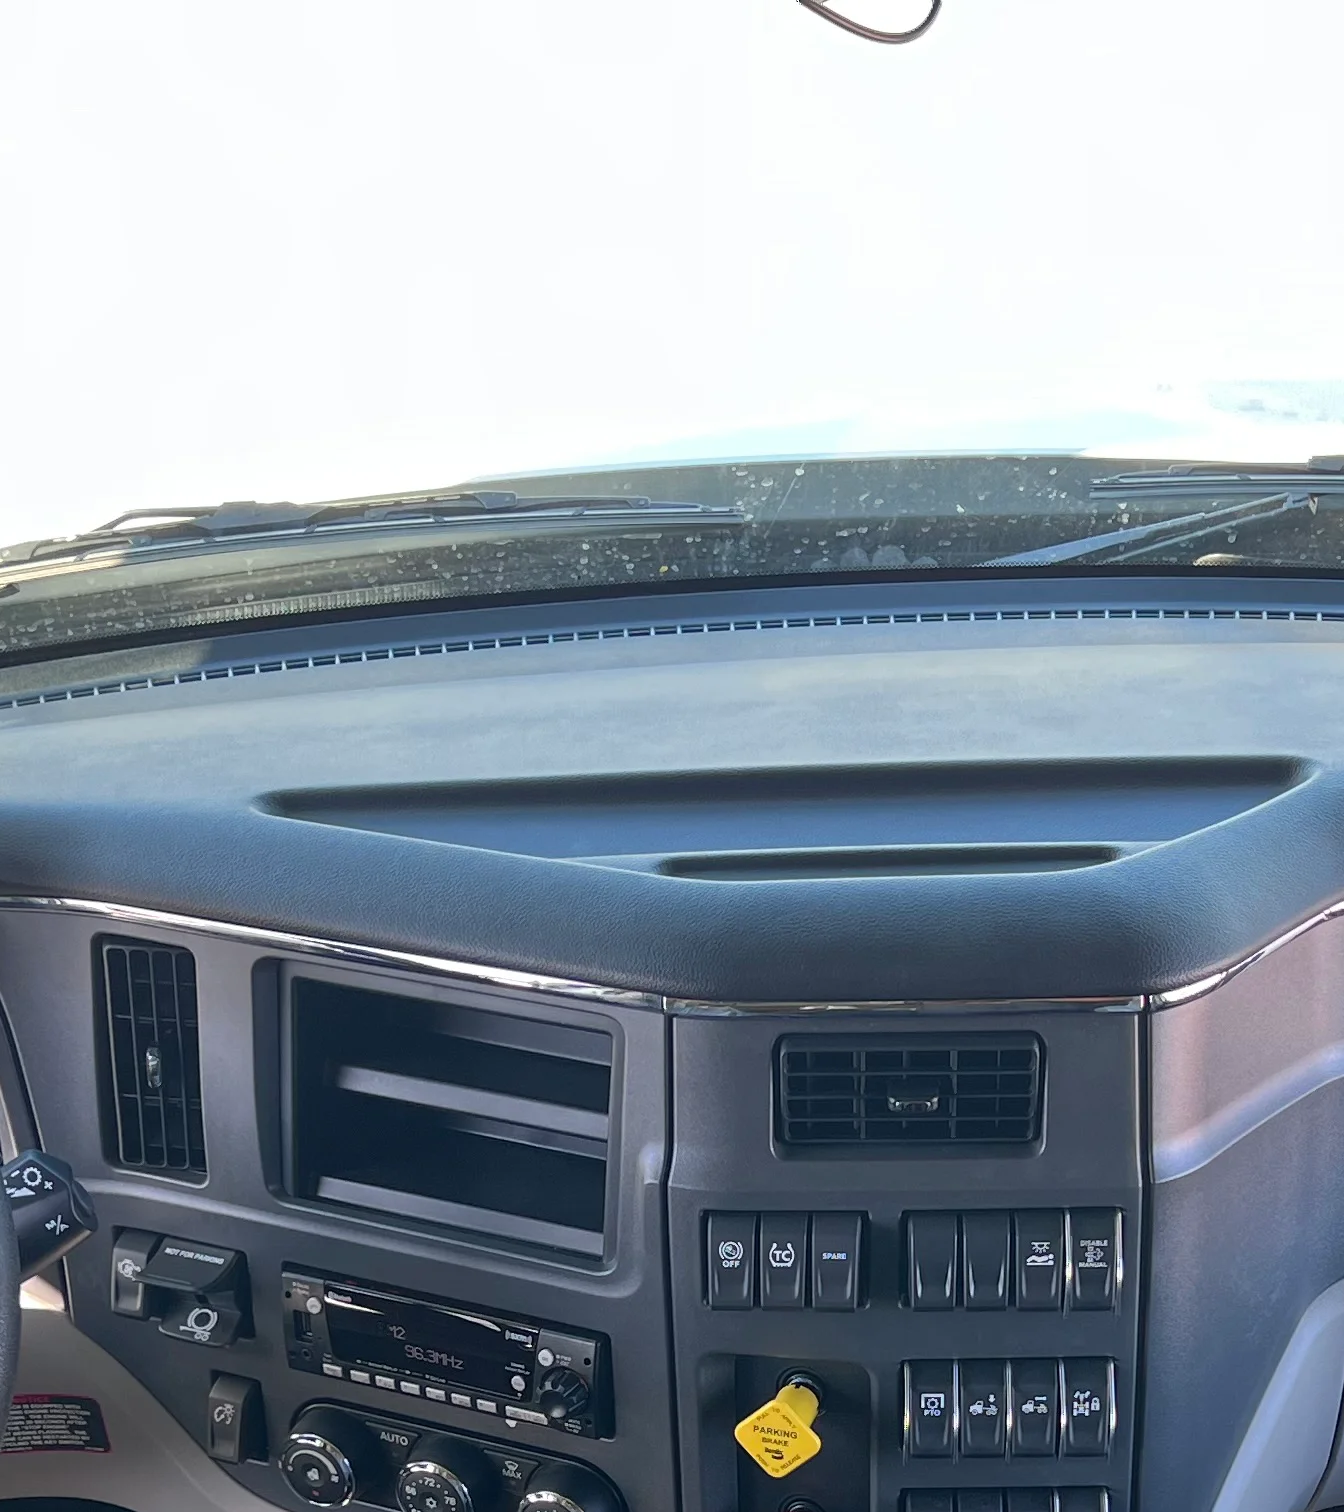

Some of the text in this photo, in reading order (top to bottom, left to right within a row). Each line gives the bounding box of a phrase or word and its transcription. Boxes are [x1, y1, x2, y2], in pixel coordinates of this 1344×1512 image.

[164, 1247, 225, 1265] NOT FOR PARKING
[773, 1250, 791, 1262] TC
[822, 1252, 847, 1260] SPARE
[722, 1260, 740, 1268] OFF
[924, 1409, 941, 1417] PTO
[753, 1425, 798, 1439] PARKING
[380, 1431, 408, 1446] AUTO
[762, 1437, 789, 1447] BRAKE
[502, 1468, 523, 1480] MAX
[423, 1477, 436, 1487] 72
